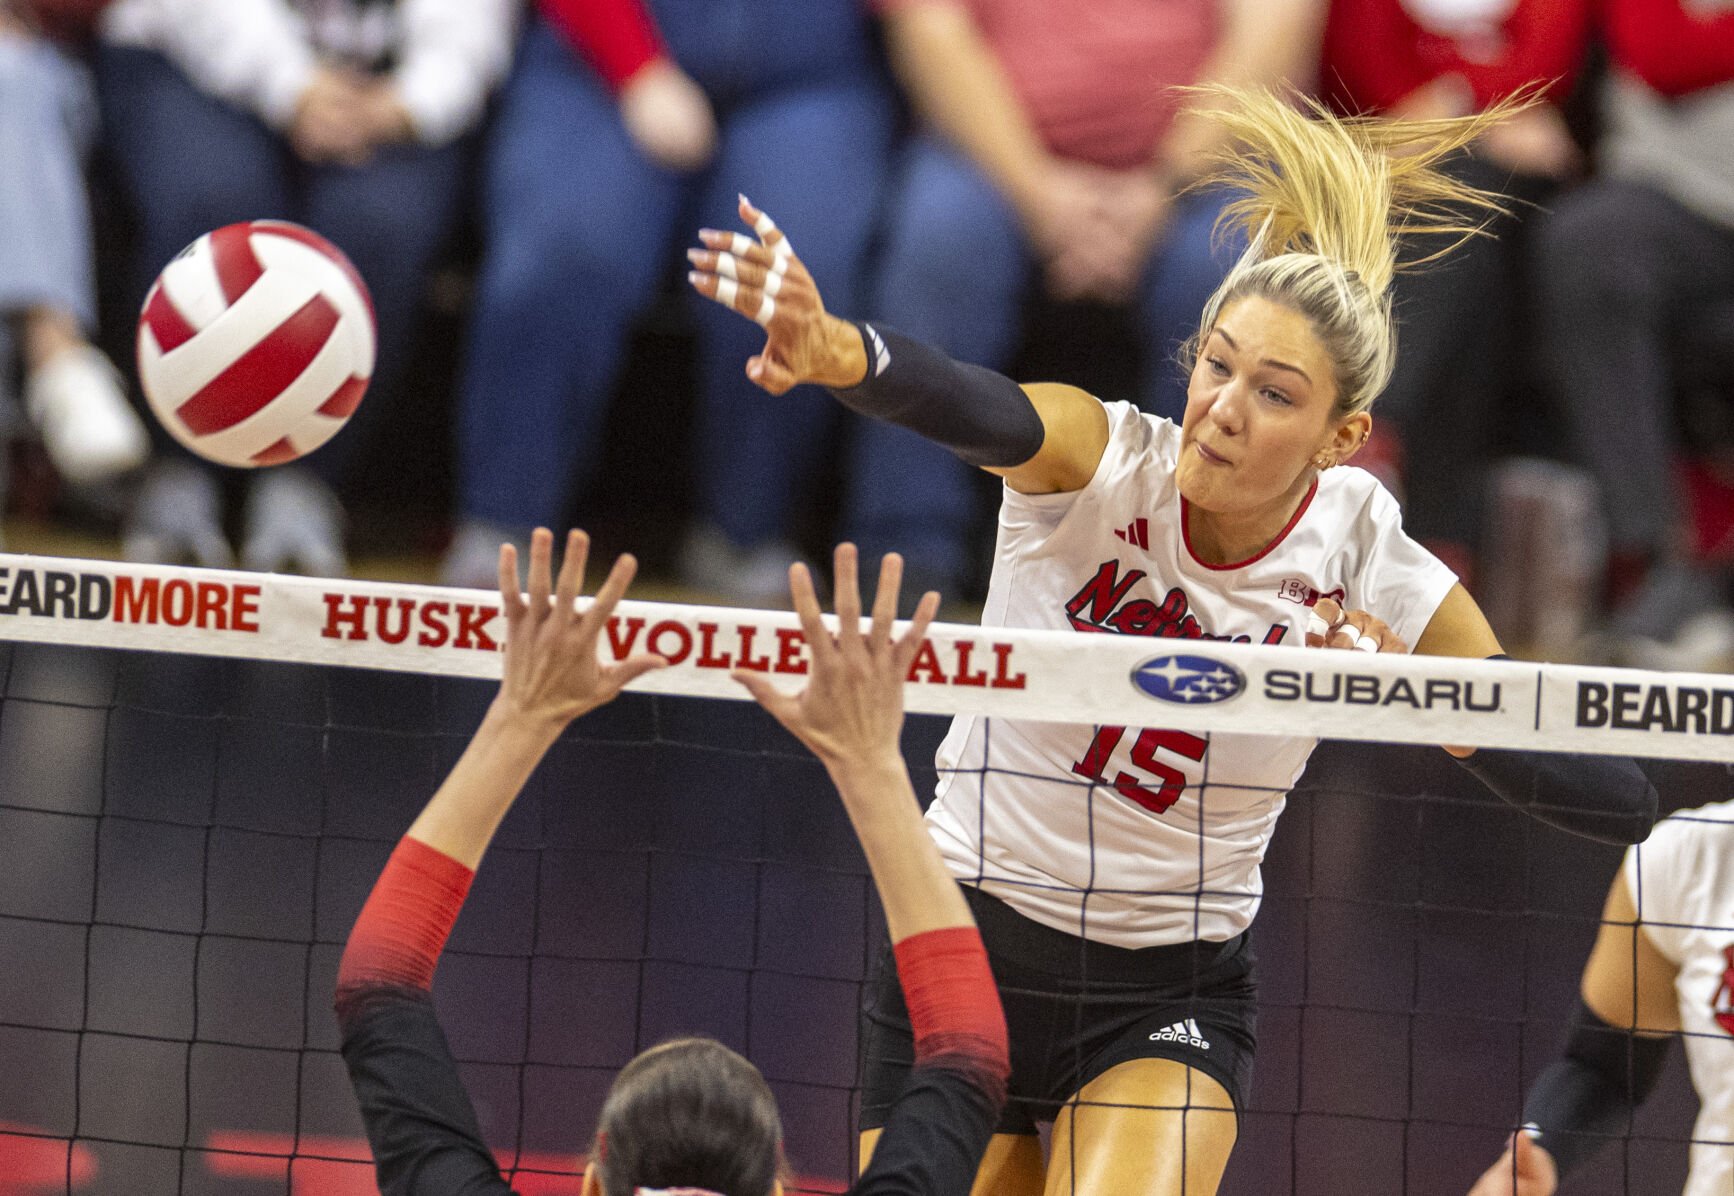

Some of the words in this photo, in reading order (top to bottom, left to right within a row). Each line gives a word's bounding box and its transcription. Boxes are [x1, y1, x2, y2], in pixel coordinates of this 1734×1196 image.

[321, 593, 509, 652] HUSK
[604, 616, 1027, 690] VOLLEALL
[1264, 669, 1502, 713] SUBARU
[1576, 680, 1734, 735] BEARD
[1071, 725, 1209, 814] 15
[1148, 1030, 1210, 1050] adidas
